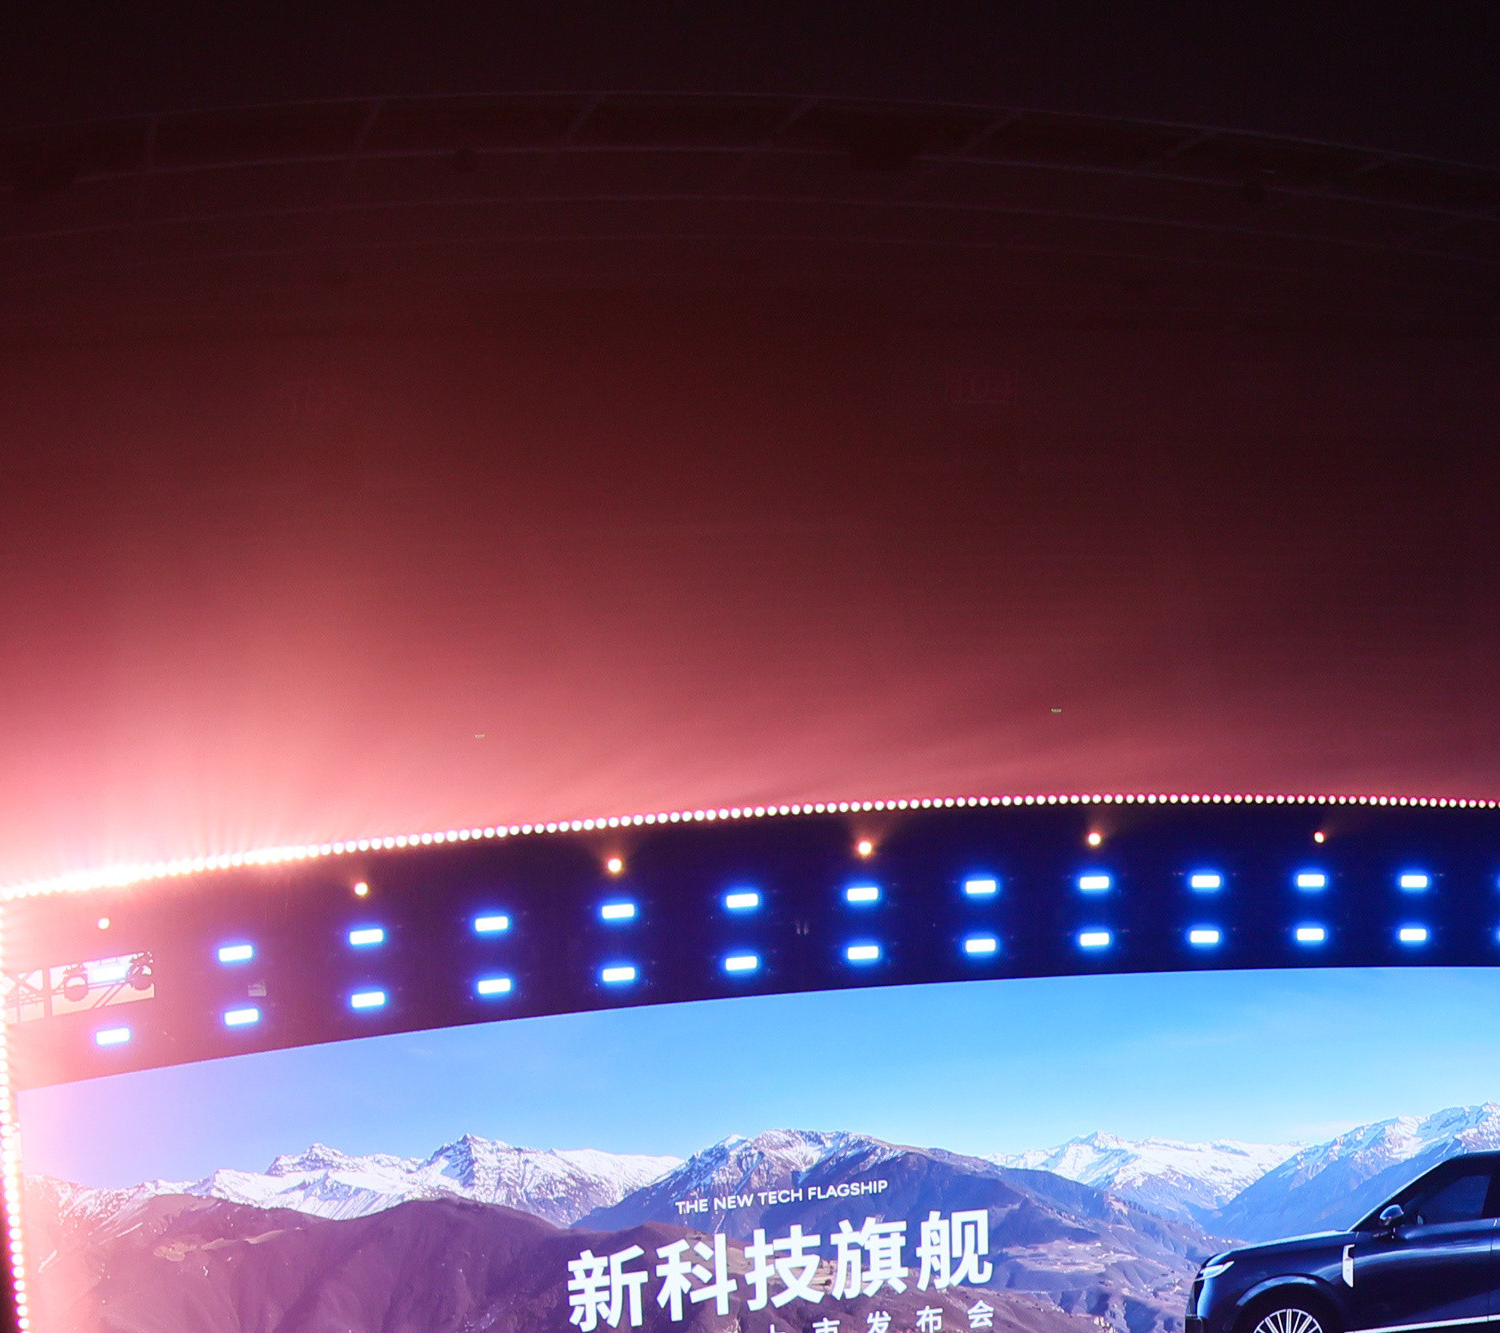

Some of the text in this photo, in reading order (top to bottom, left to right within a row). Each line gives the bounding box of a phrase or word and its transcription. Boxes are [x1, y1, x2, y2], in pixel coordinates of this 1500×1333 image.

[675, 1179, 889, 1216] THE NEW TECH FLAGSHIP
[566, 1208, 994, 1333] 新科技旗舰
